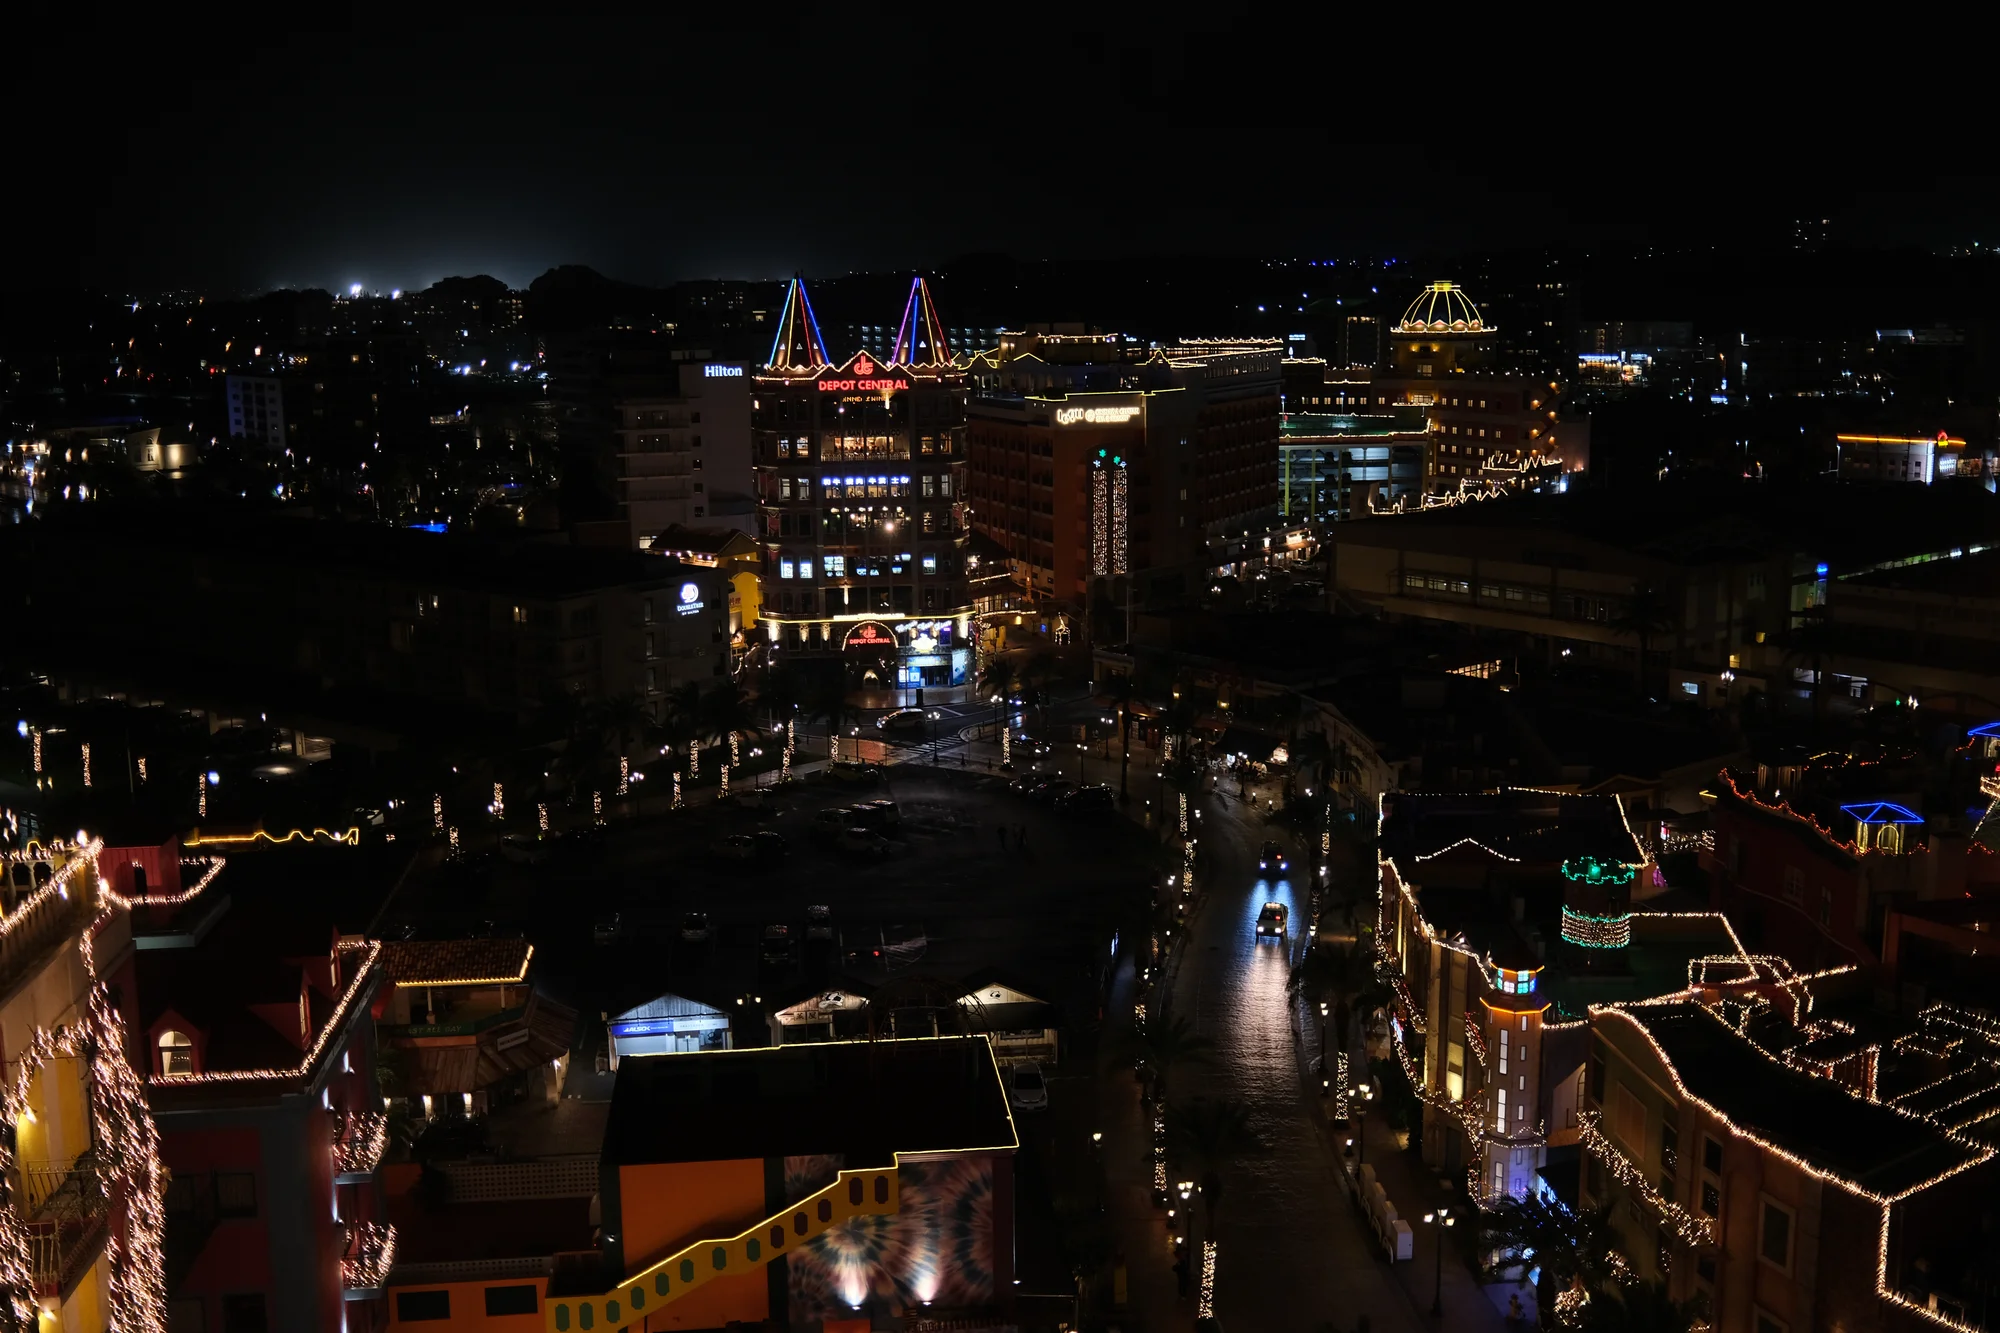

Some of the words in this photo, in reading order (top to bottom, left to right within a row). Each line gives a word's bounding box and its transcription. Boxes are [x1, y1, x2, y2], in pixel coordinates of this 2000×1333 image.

[704, 365, 743, 377] Hilton
[818, 380, 856, 391] DEPOT
[857, 379, 909, 391] CENTRAL
